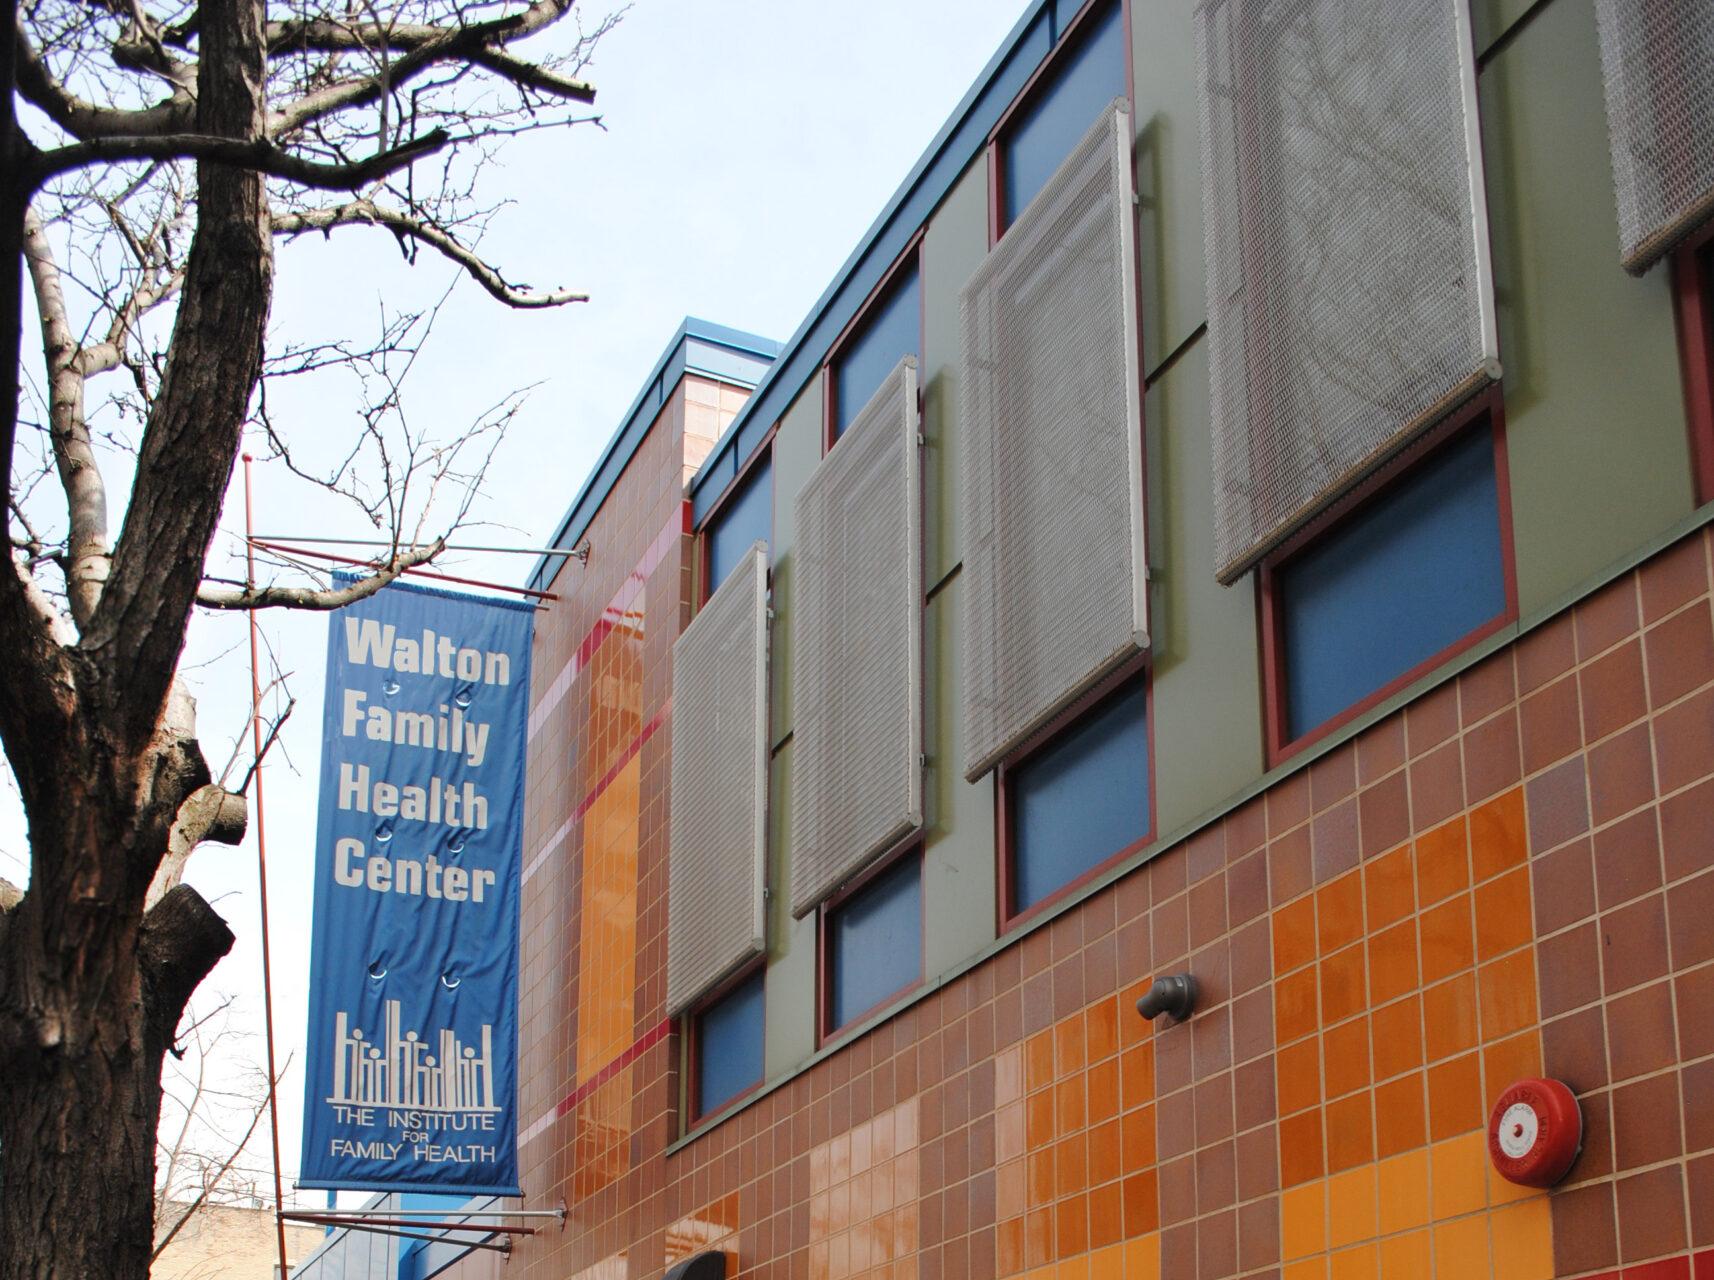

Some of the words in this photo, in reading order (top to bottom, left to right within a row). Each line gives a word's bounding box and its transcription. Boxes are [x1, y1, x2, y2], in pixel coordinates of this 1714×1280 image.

[346, 616, 510, 686] Walton
[342, 688, 490, 767] Family
[339, 763, 488, 829] Health
[334, 838, 496, 903] Center
[333, 1106, 375, 1127] THE
[388, 1111, 495, 1130] INSTITUTE
[403, 1131, 429, 1143] FOR
[331, 1139, 403, 1160] FAMILY
[414, 1145, 496, 1163] HEALTH
